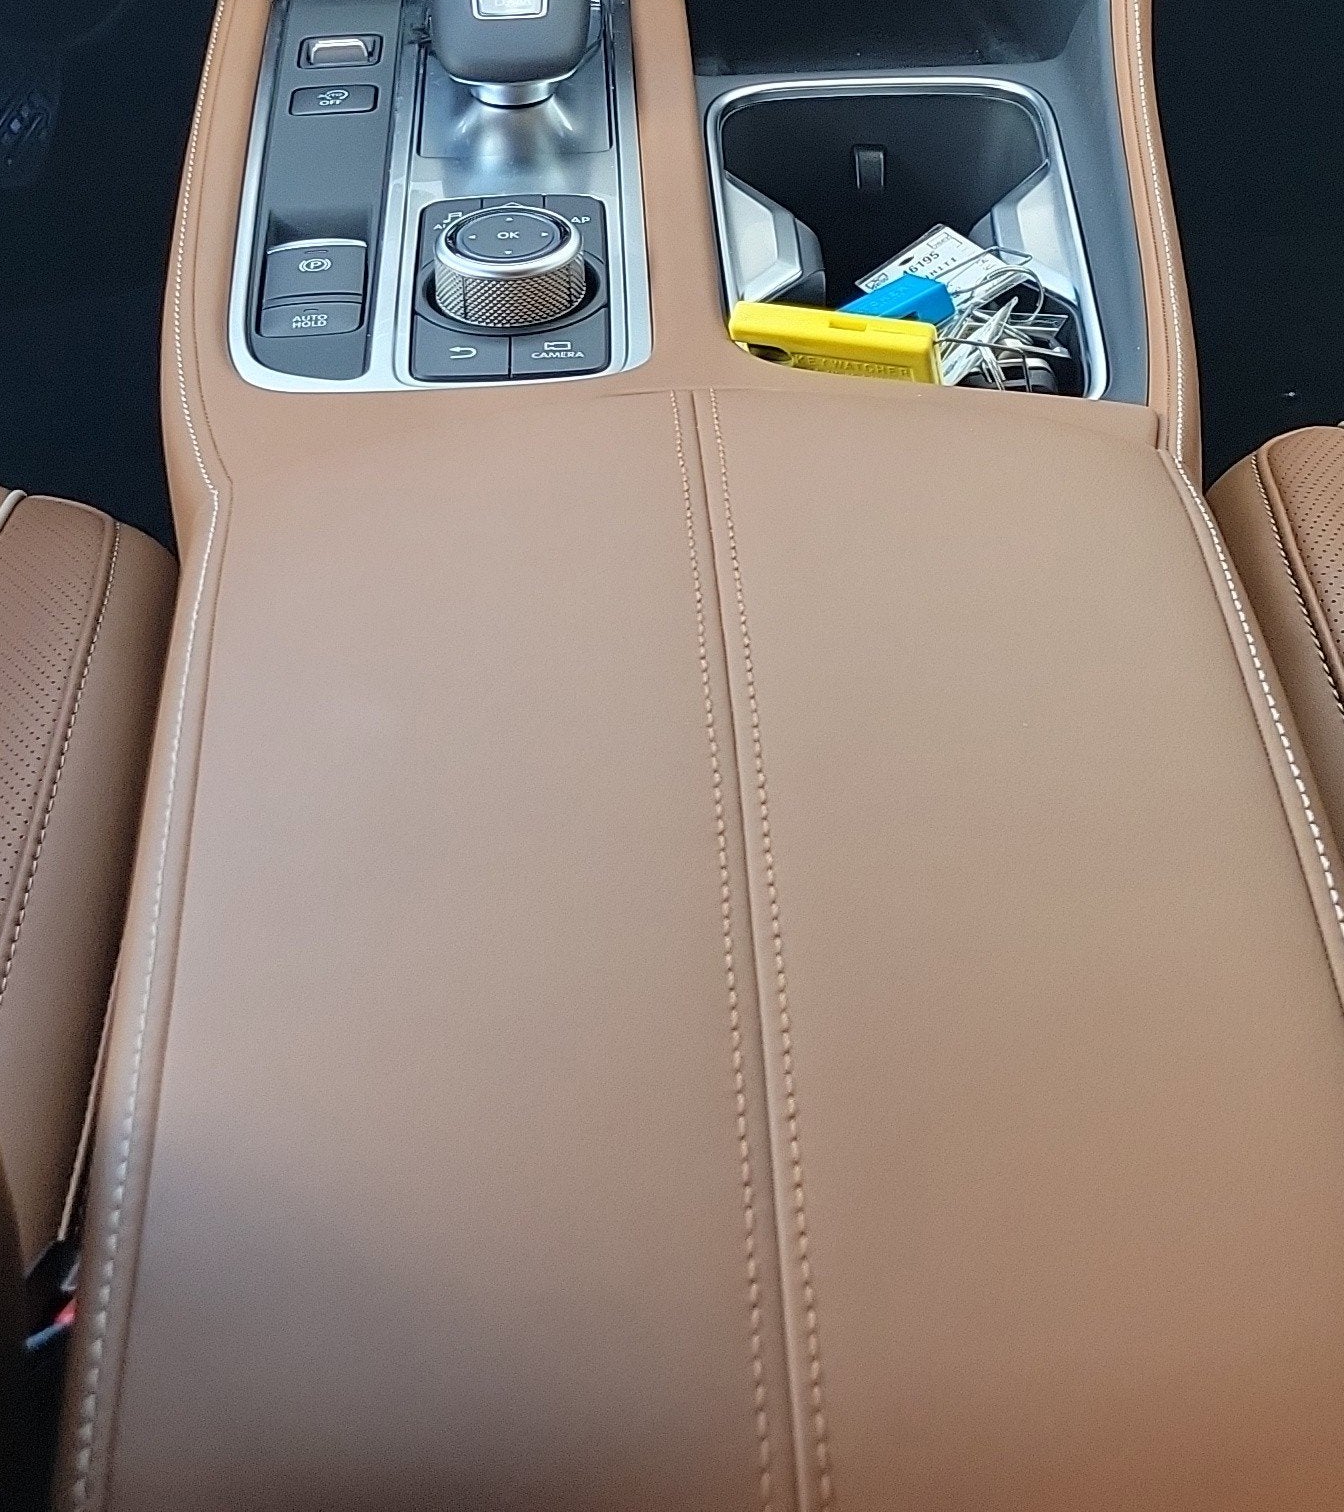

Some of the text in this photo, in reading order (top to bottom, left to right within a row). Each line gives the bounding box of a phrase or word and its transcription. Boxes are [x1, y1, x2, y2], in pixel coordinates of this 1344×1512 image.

[570, 216, 591, 224] AP
[497, 231, 520, 239] OK
[292, 314, 328, 322] AUTO
[292, 320, 327, 329] HOLD
[531, 351, 585, 359] CAMERA
[792, 353, 911, 377] KEYWATCHER
